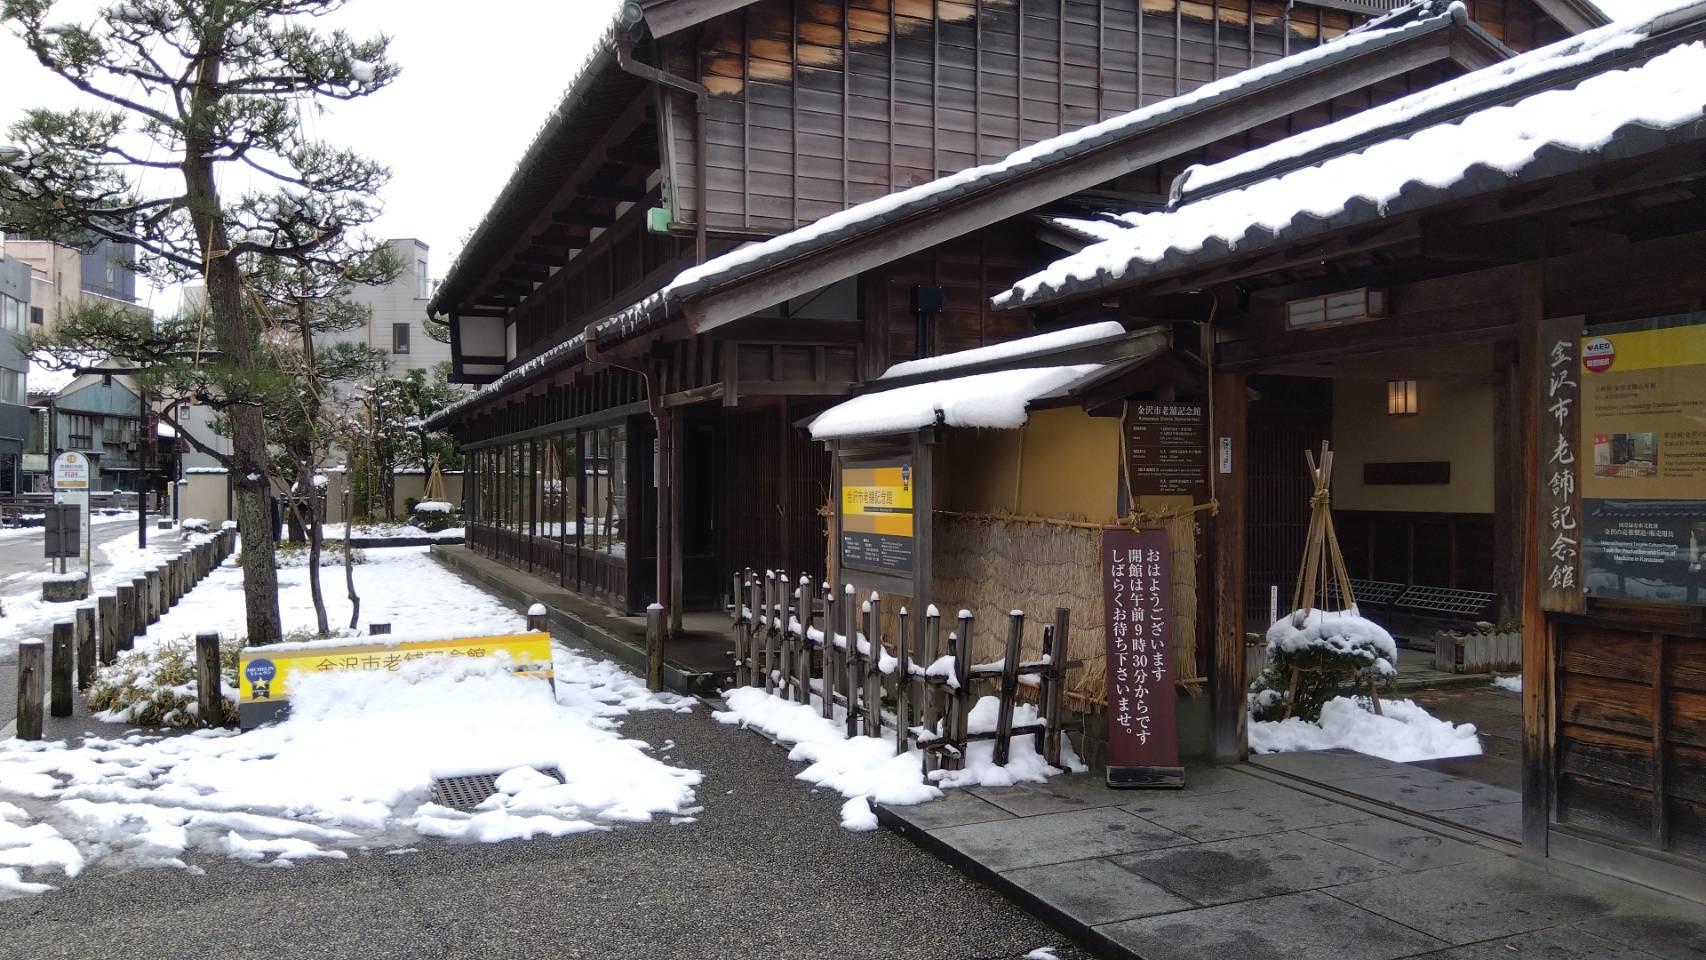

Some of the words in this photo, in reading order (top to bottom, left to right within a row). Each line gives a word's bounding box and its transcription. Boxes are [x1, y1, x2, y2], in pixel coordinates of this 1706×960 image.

[1138, 405, 1202, 416] 金沢市老舗記念館
[1548, 340, 1577, 589] 金沢市老舗記念館
[1111, 550, 1132, 734] しばらくお待ち下さいませ。
[1129, 550, 1151, 745] 開館は午前9時30分からです
[1147, 550, 1166, 681] おはようございます
